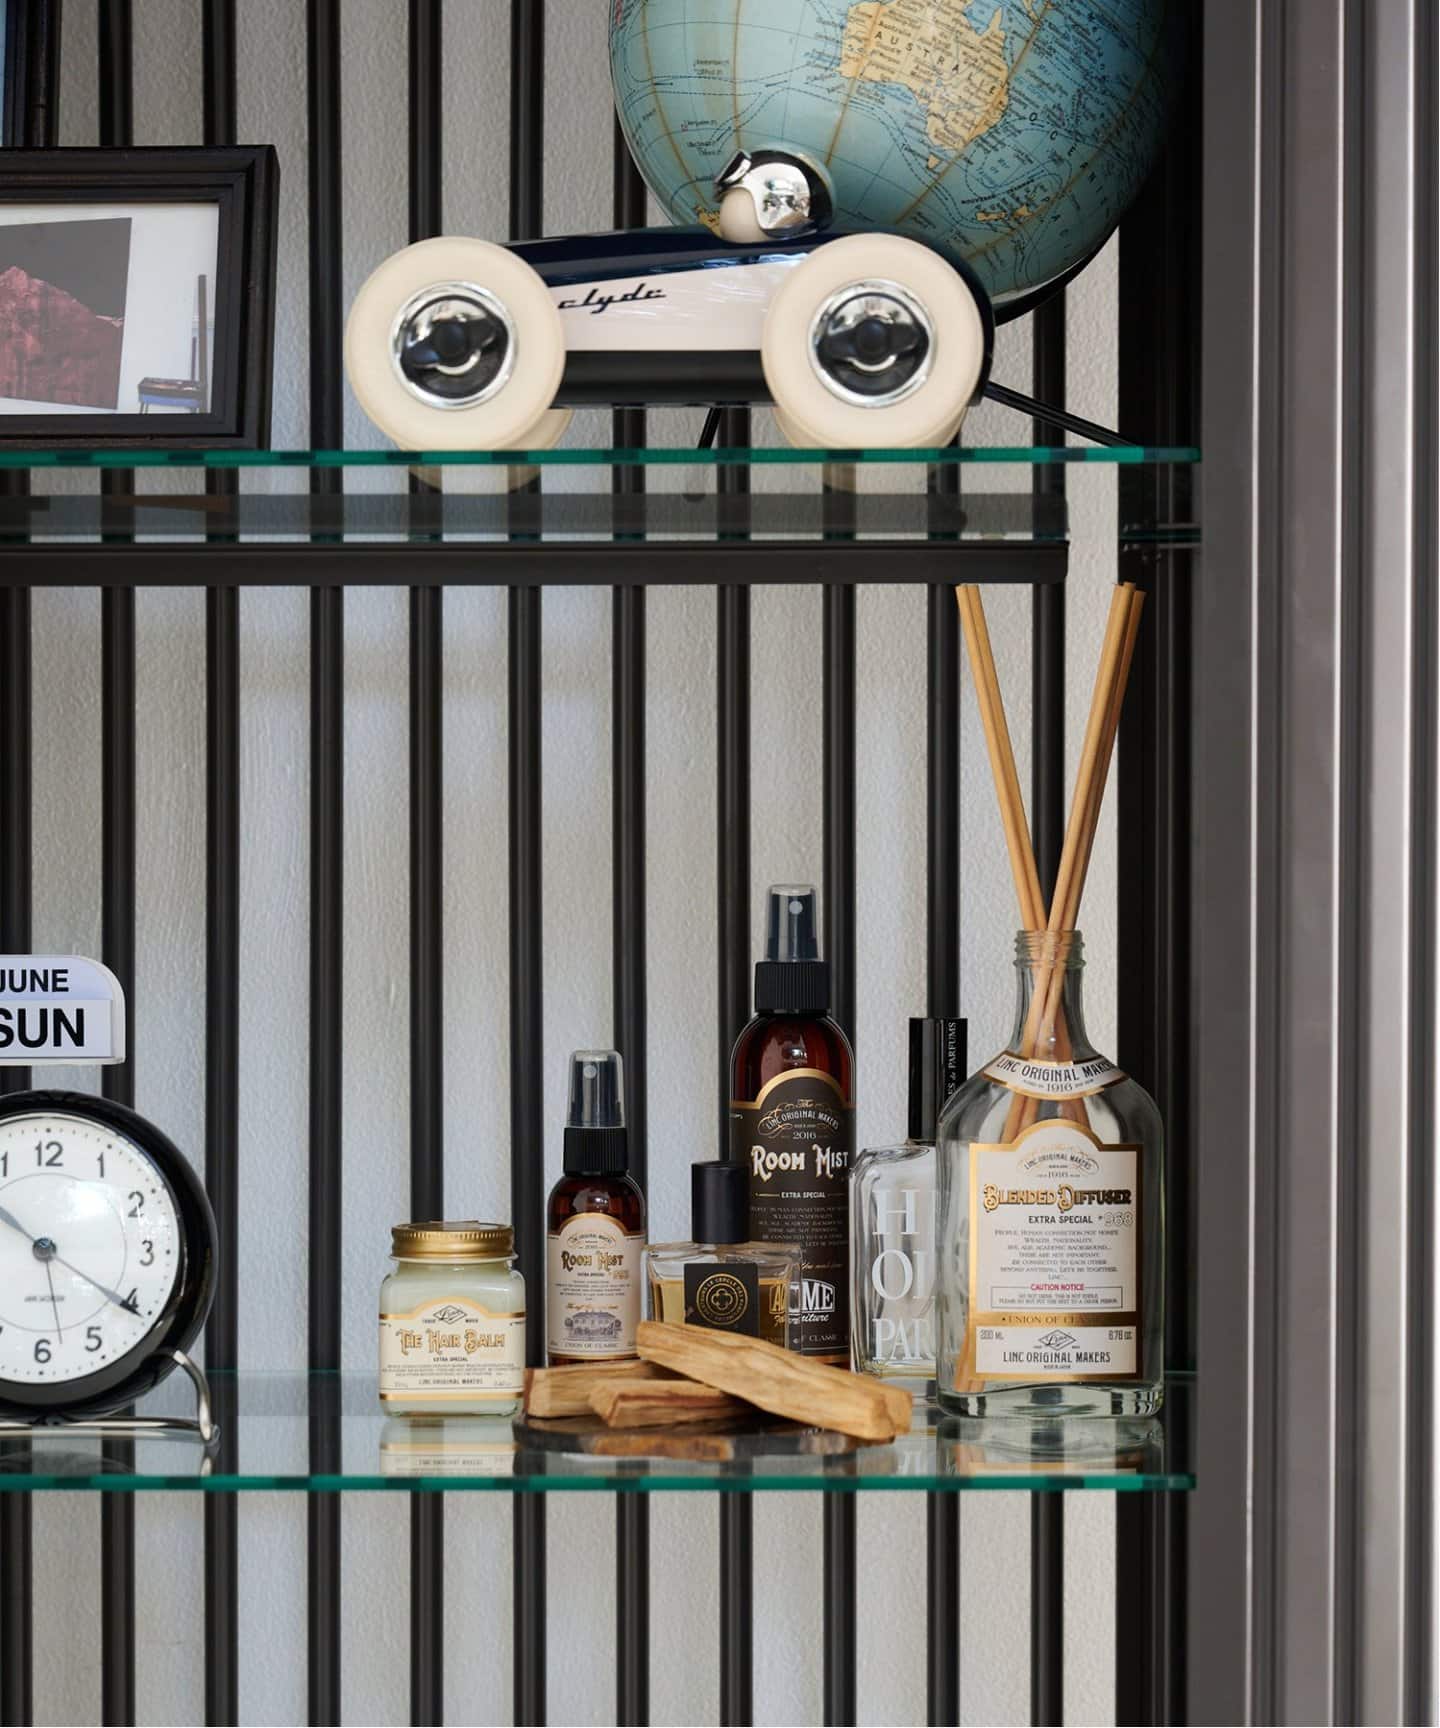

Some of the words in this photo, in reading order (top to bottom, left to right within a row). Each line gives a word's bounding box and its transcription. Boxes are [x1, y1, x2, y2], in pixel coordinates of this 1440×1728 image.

[557, 283, 667, 314] clyde
[0, 968, 69, 993] JUNE
[0, 1007, 85, 1049] SUN
[1021, 1064, 1080, 1082] ORIGINAL
[781, 1110, 816, 1122] ORIGINAL
[35, 1140, 64, 1167] 12
[96, 1152, 105, 1178] 1
[751, 1145, 806, 1182] ROOM
[812, 1144, 848, 1178] MIST
[127, 1190, 145, 1218] 2
[781, 1191, 801, 1199] EXTRA
[984, 1183, 1057, 1213] BLENDED
[1058, 1183, 1132, 1213] DIFFUSER
[1028, 1215, 1056, 1224] EXTRA
[1059, 1215, 1093, 1224] SPECIAL
[139, 1239, 155, 1267] 3
[1030, 1283, 1059, 1292] CAUTION
[1061, 1283, 1084, 1292] NOTICE
[1008, 1315, 1041, 1324] UNION
[1046, 1315, 1057, 1324] OF
[33, 1338, 52, 1364] 6
[84, 1326, 103, 1352] 5
[395, 1328, 423, 1356] THE
[425, 1328, 461, 1356] HAIR
[464, 1328, 506, 1355] BALM
[1003, 1351, 1024, 1363] LINC
[1026, 1351, 1072, 1363] ORIGINAL
[1076, 1351, 1111, 1363] MAKERS
